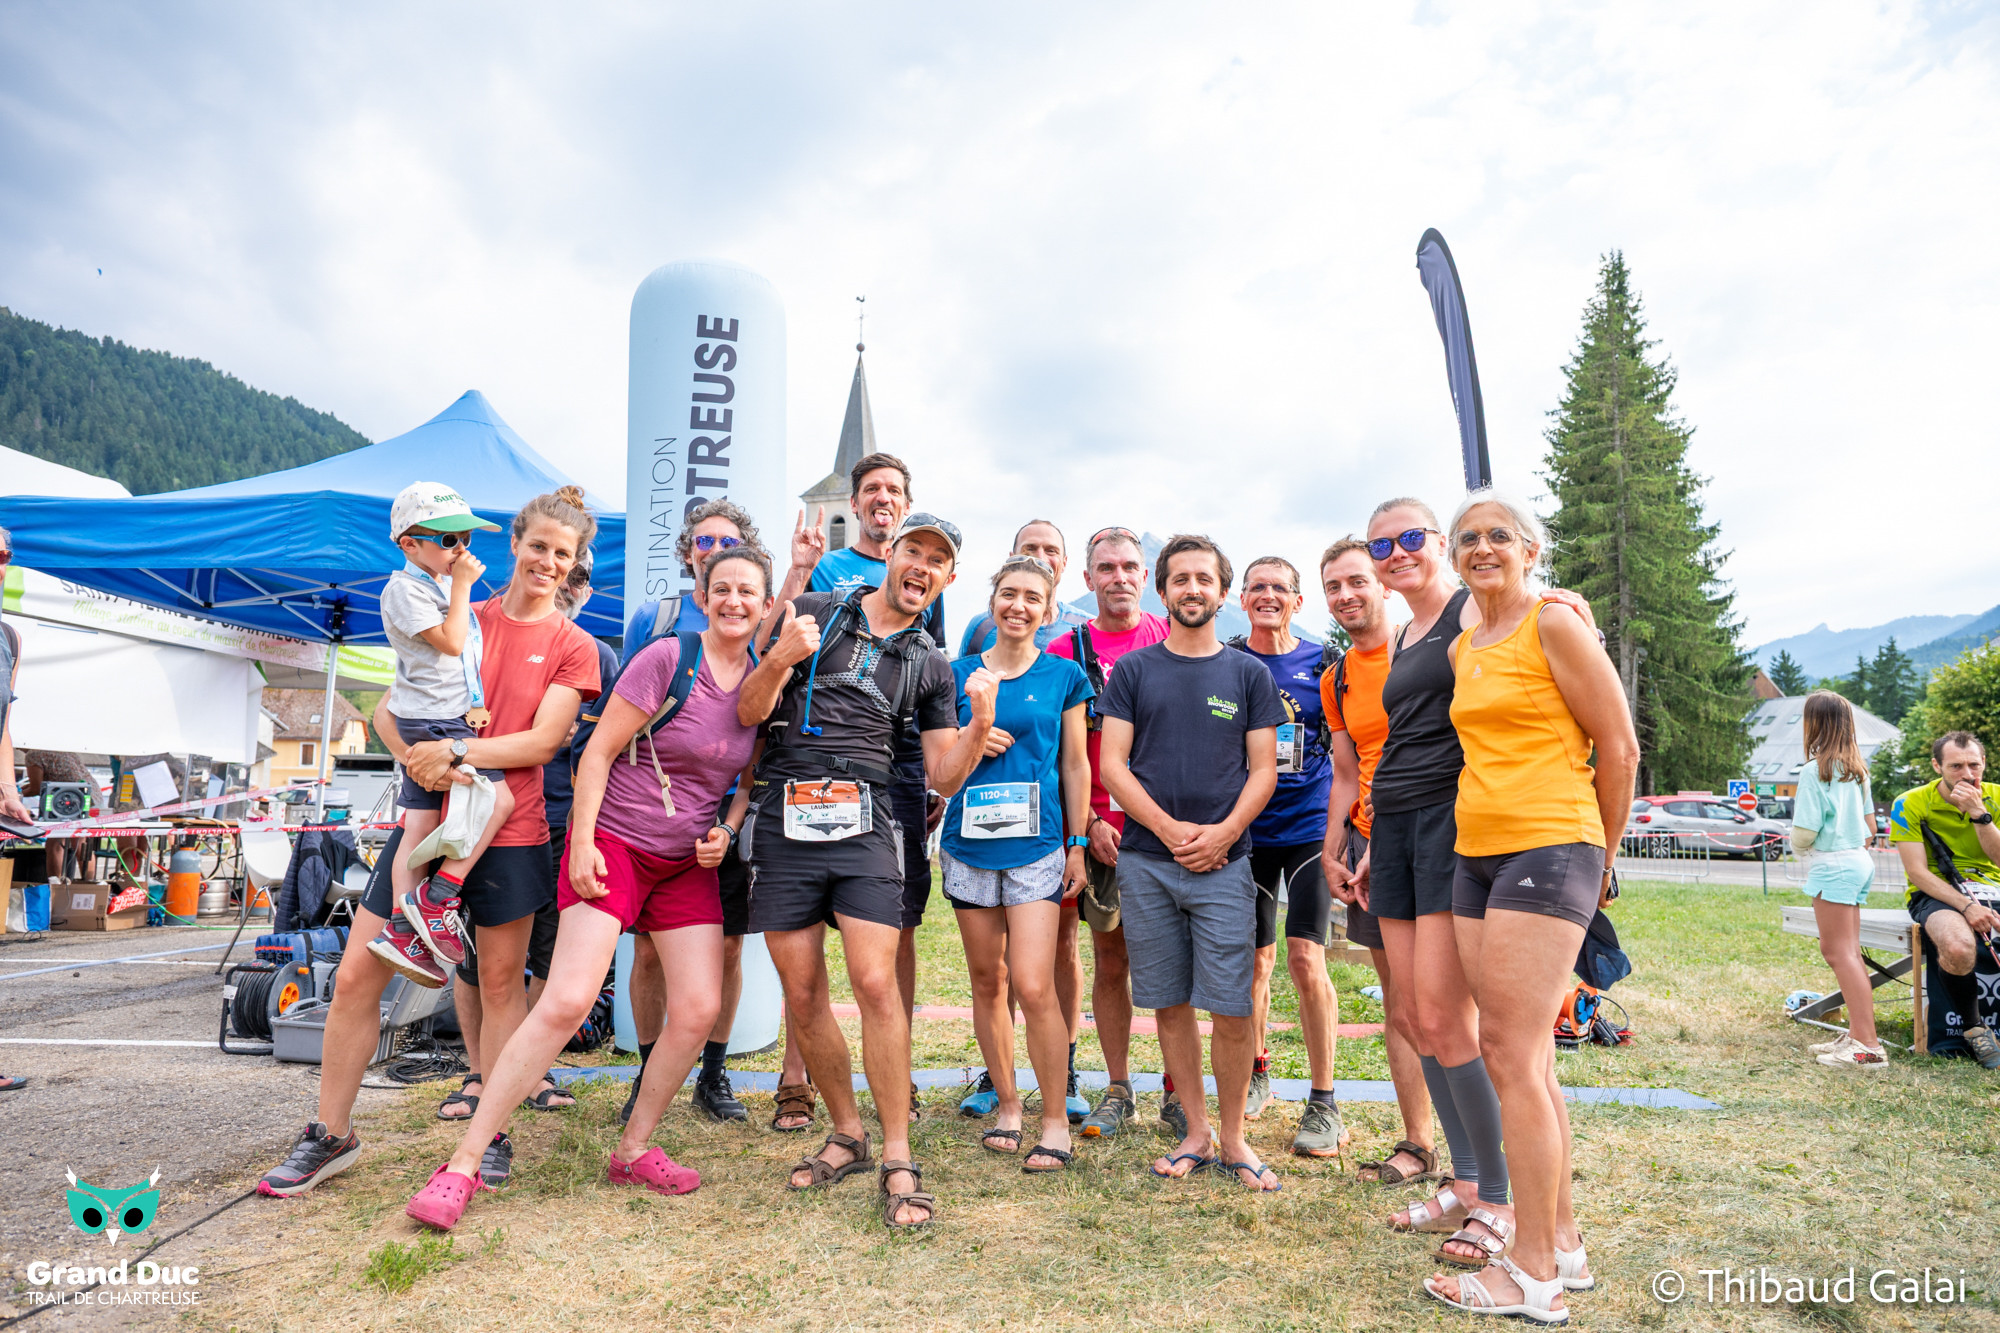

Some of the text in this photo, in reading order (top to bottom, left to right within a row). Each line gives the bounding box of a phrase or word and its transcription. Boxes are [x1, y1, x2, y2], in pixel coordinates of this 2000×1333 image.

[645, 437, 677, 602] STINATION
[214, 634, 246, 650] massif
[245, 638, 257, 651] de
[848, 637, 863, 669] Raidlig
[1290, 698, 1302, 713] KM
[810, 789, 833, 798] 905
[980, 789, 1010, 800] 1120-4
[94, 830, 142, 838] RAIDLIGHT
[428, 918, 446, 932] N
[1945, 1011, 1998, 1026] Grd
